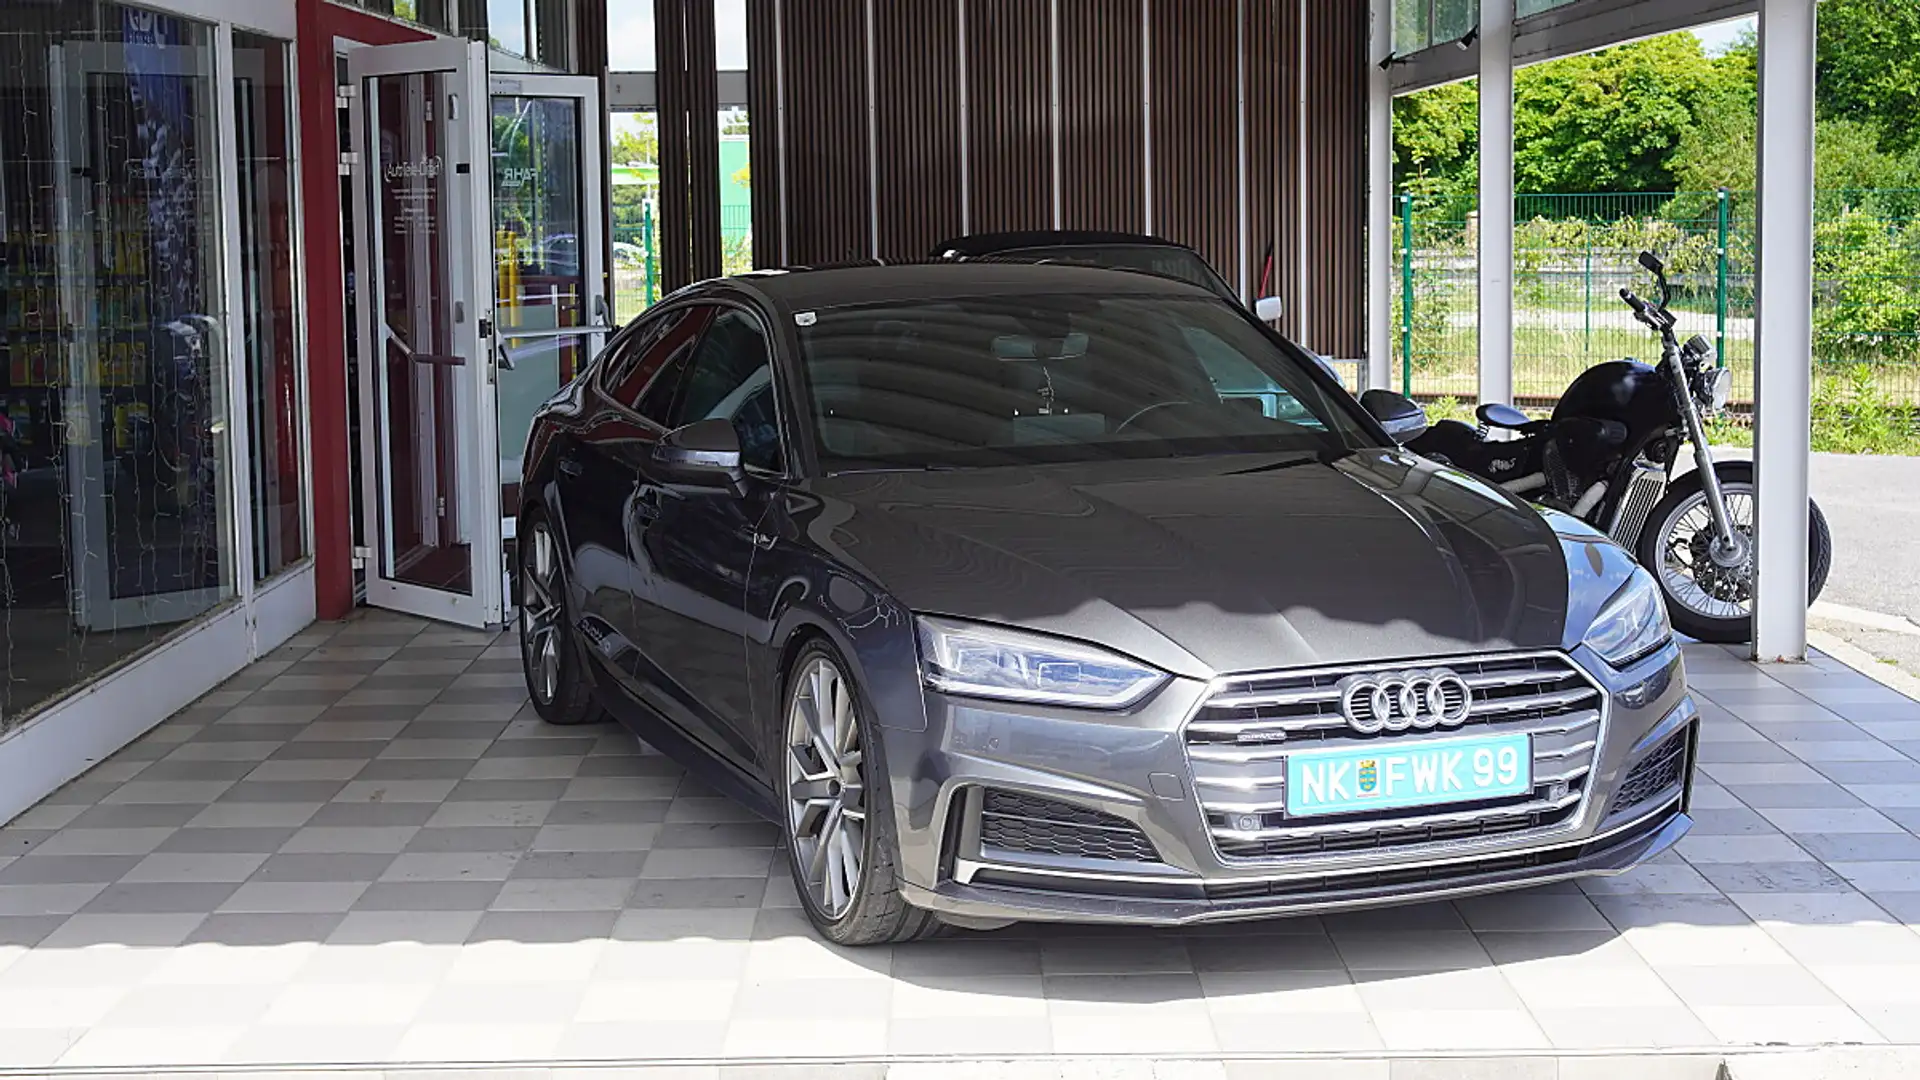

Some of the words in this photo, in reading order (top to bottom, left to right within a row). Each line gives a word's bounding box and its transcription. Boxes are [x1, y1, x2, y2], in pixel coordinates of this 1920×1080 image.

[580, 619, 611, 652] quatto
[1302, 761, 1350, 803] NK
[1385, 751, 1463, 796] FWK
[1472, 746, 1518, 787] 99
